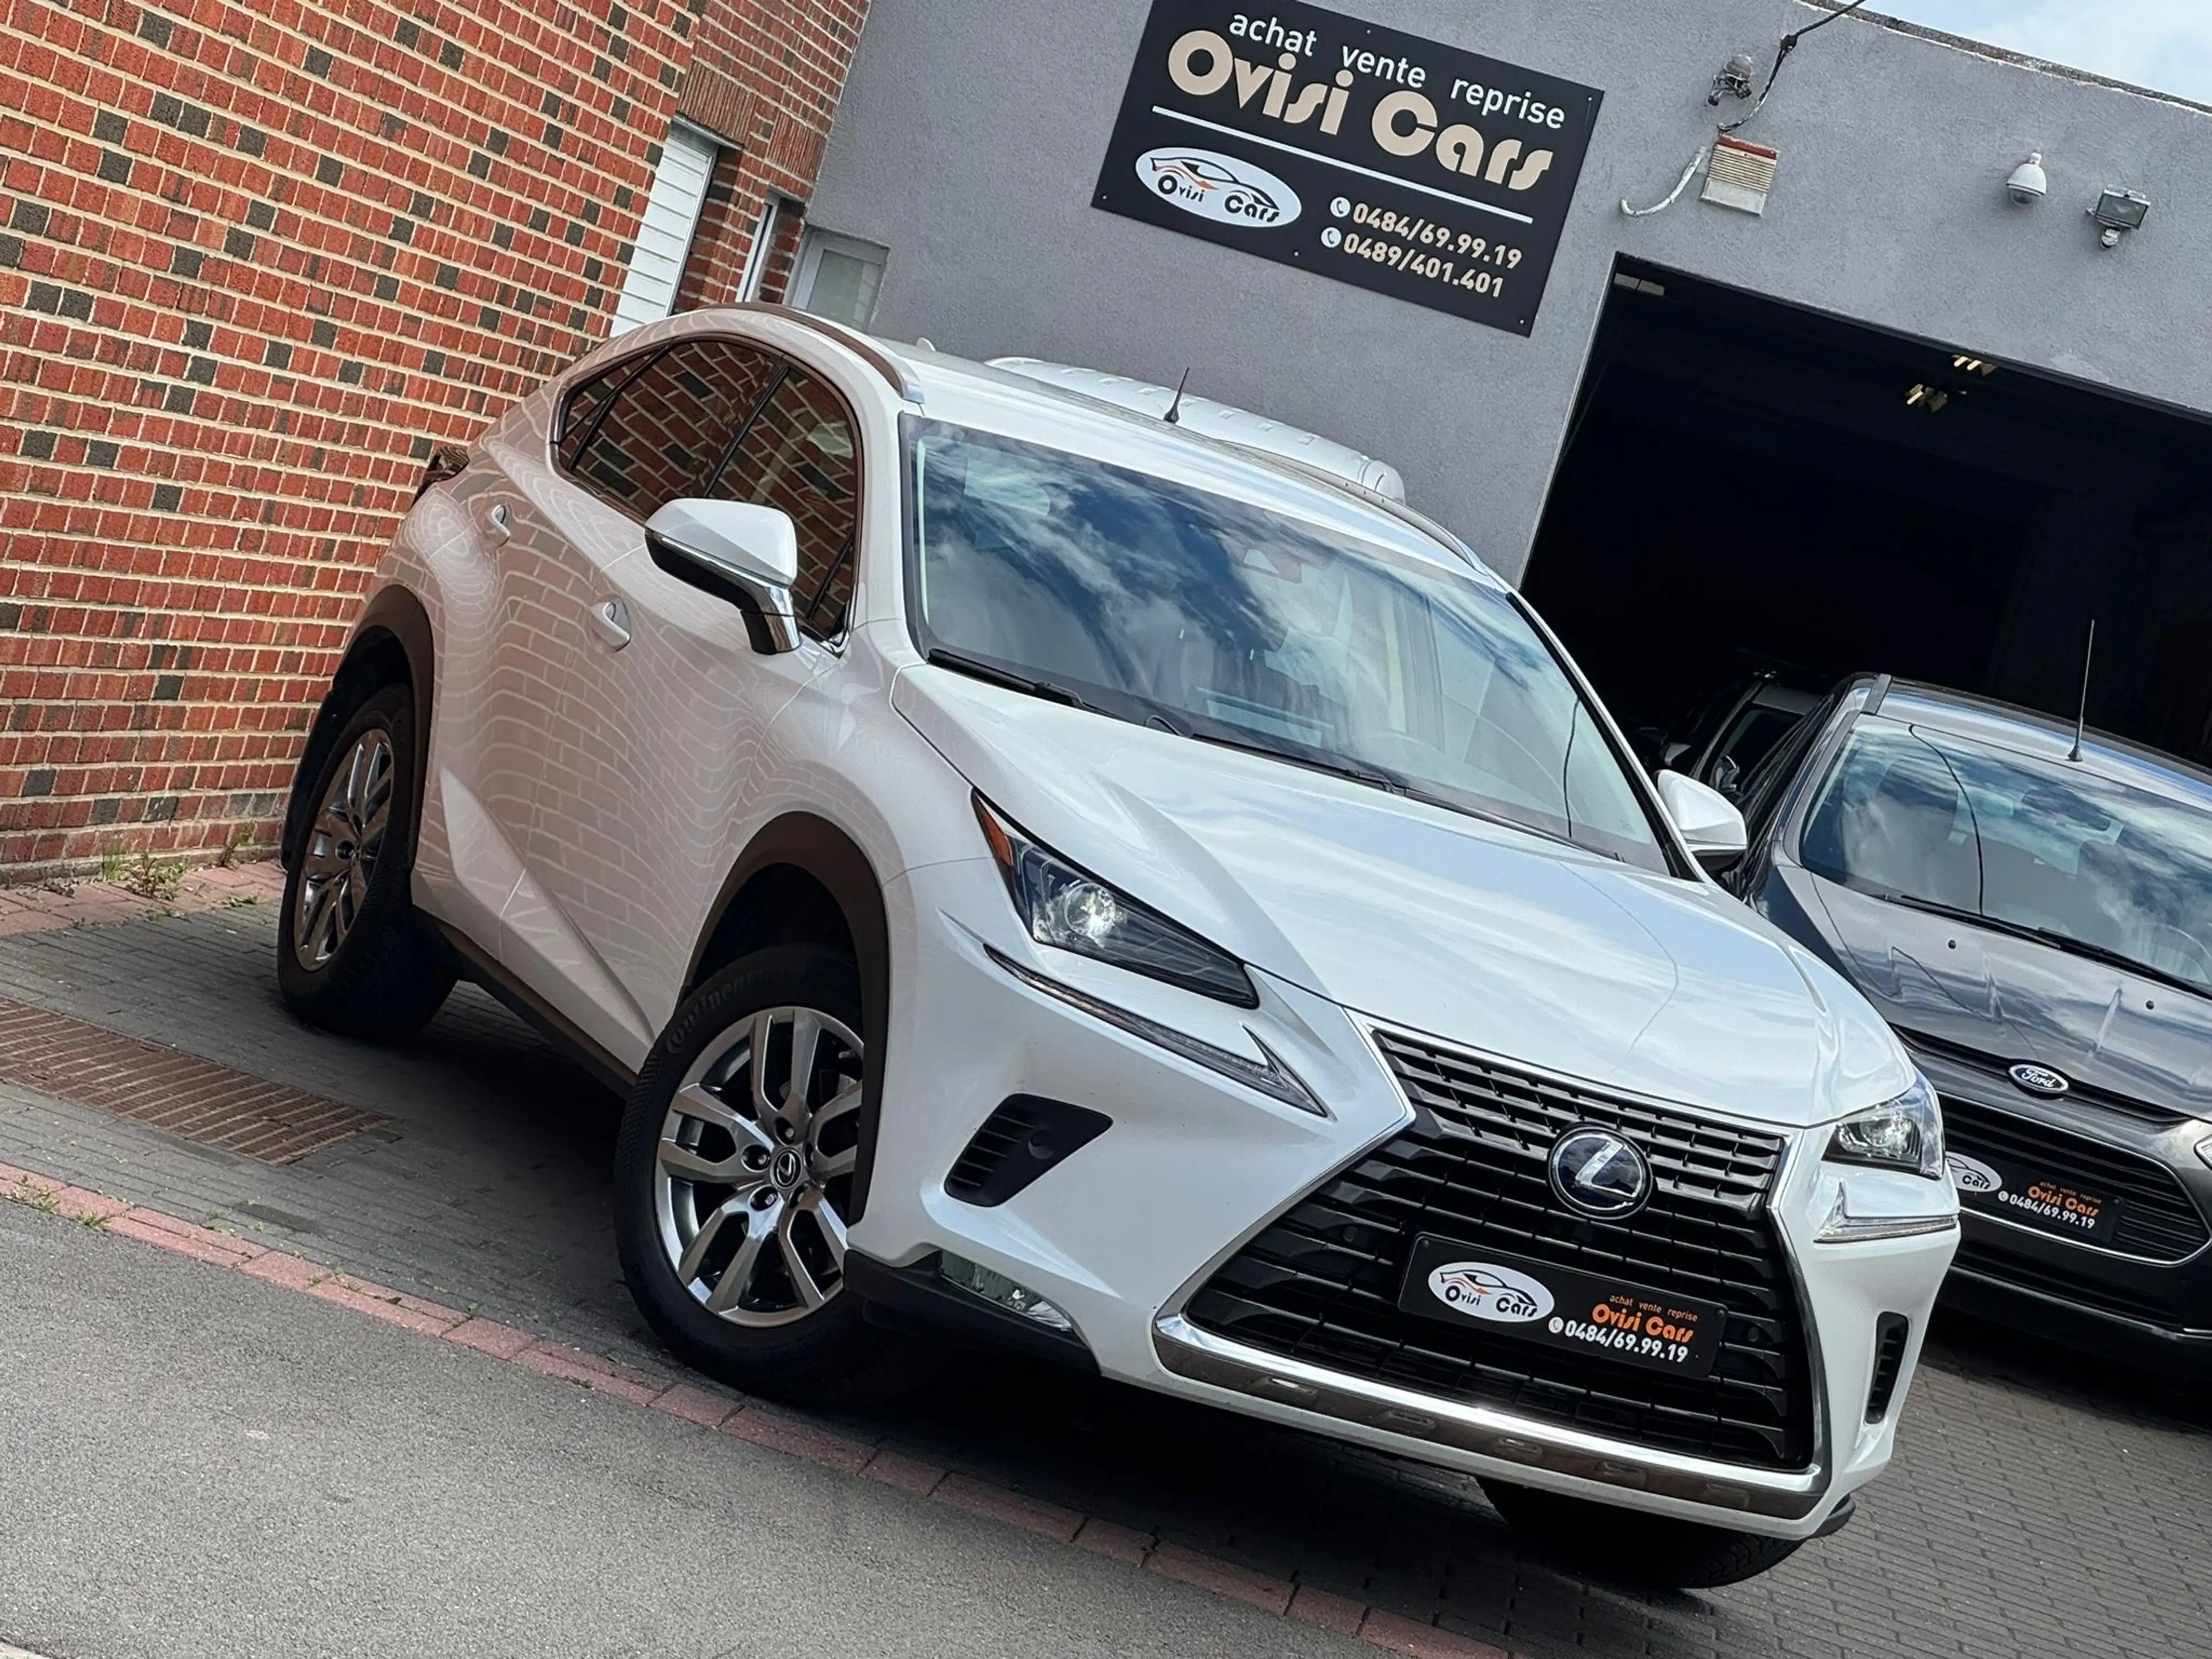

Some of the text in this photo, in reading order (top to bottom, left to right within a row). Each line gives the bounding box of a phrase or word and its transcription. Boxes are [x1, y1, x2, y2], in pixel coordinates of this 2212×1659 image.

[1229, 13, 1565, 130] achat vente reprise
[1168, 30, 1554, 191] Ovisi Cars
[1157, 175, 1279, 223] Ovisi Cars
[1353, 203, 1522, 270] 0484/69.99.19
[1343, 233, 1503, 298] 0489/401.401
[2021, 1069, 2055, 1088] Ford
[1962, 1175, 1991, 1190] Cars
[2028, 1185, 2099, 1217] Ovisi Cars
[2009, 1194, 2096, 1229] 0484/69.99.19
[1445, 1285, 1538, 1317] Ovisi Cars
[1609, 1294, 1699, 1323] achat vente reprise
[1565, 1321, 1688, 1363] 0484/69.99.19
[1592, 1304, 1694, 1343] Ovisi Cars
